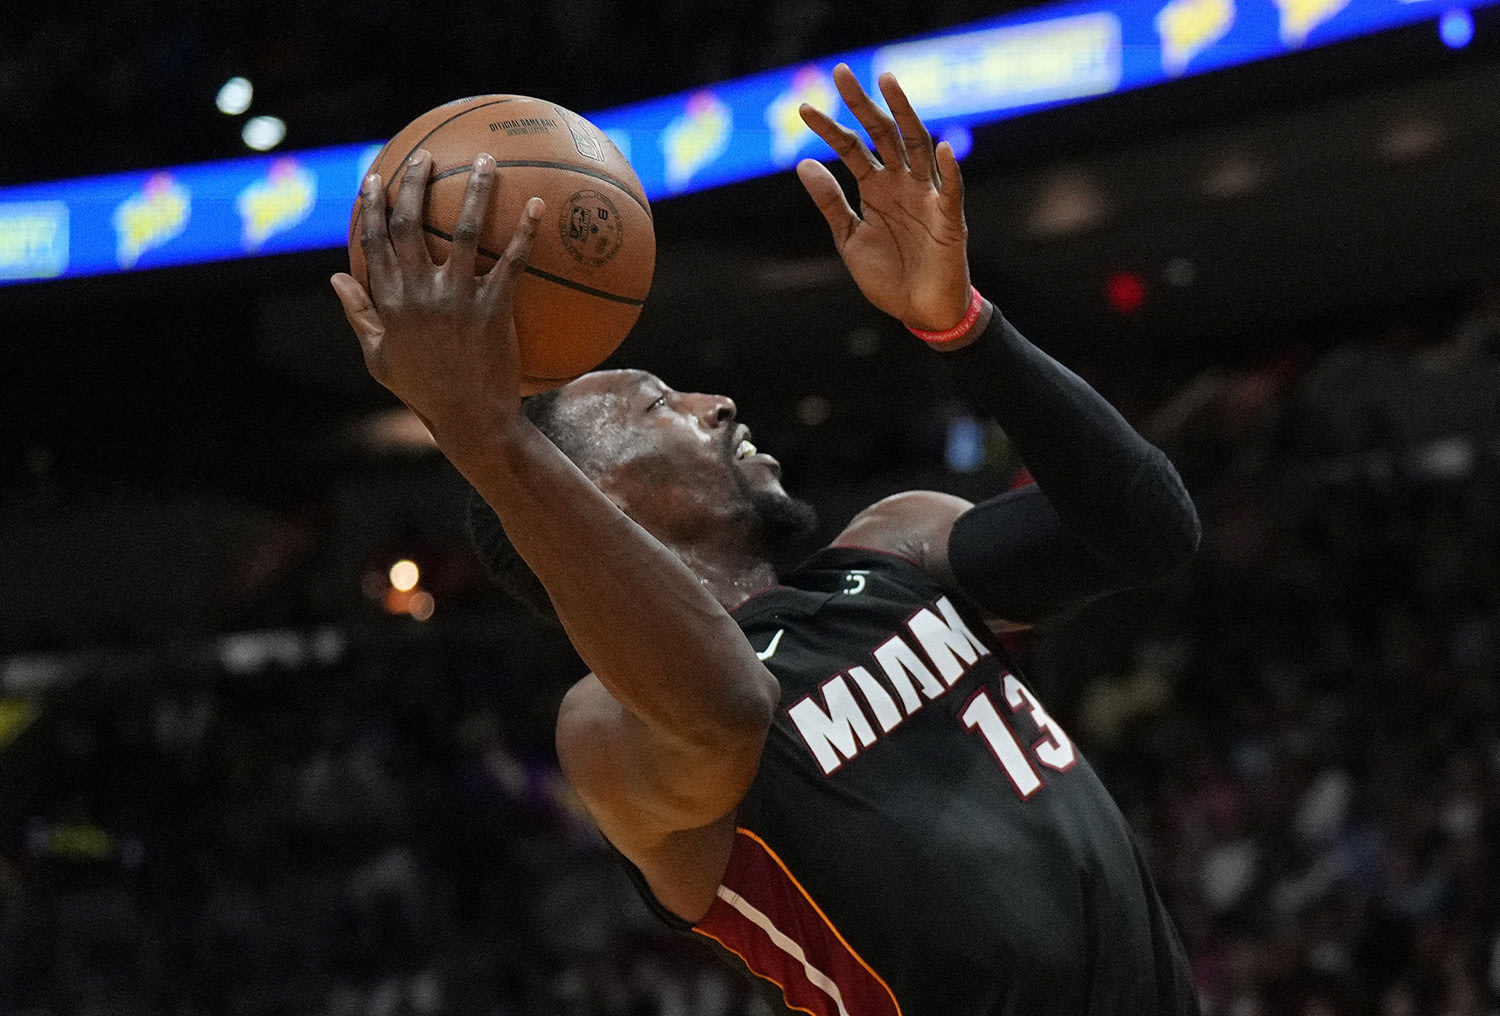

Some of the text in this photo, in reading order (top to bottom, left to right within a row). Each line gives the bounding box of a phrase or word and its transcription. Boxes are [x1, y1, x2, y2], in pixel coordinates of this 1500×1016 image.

[489, 120, 519, 132] OFFICIAL
[520, 118, 540, 128] GAME
[786, 595, 989, 778] MIAM
[958, 671, 1077, 800] 13
